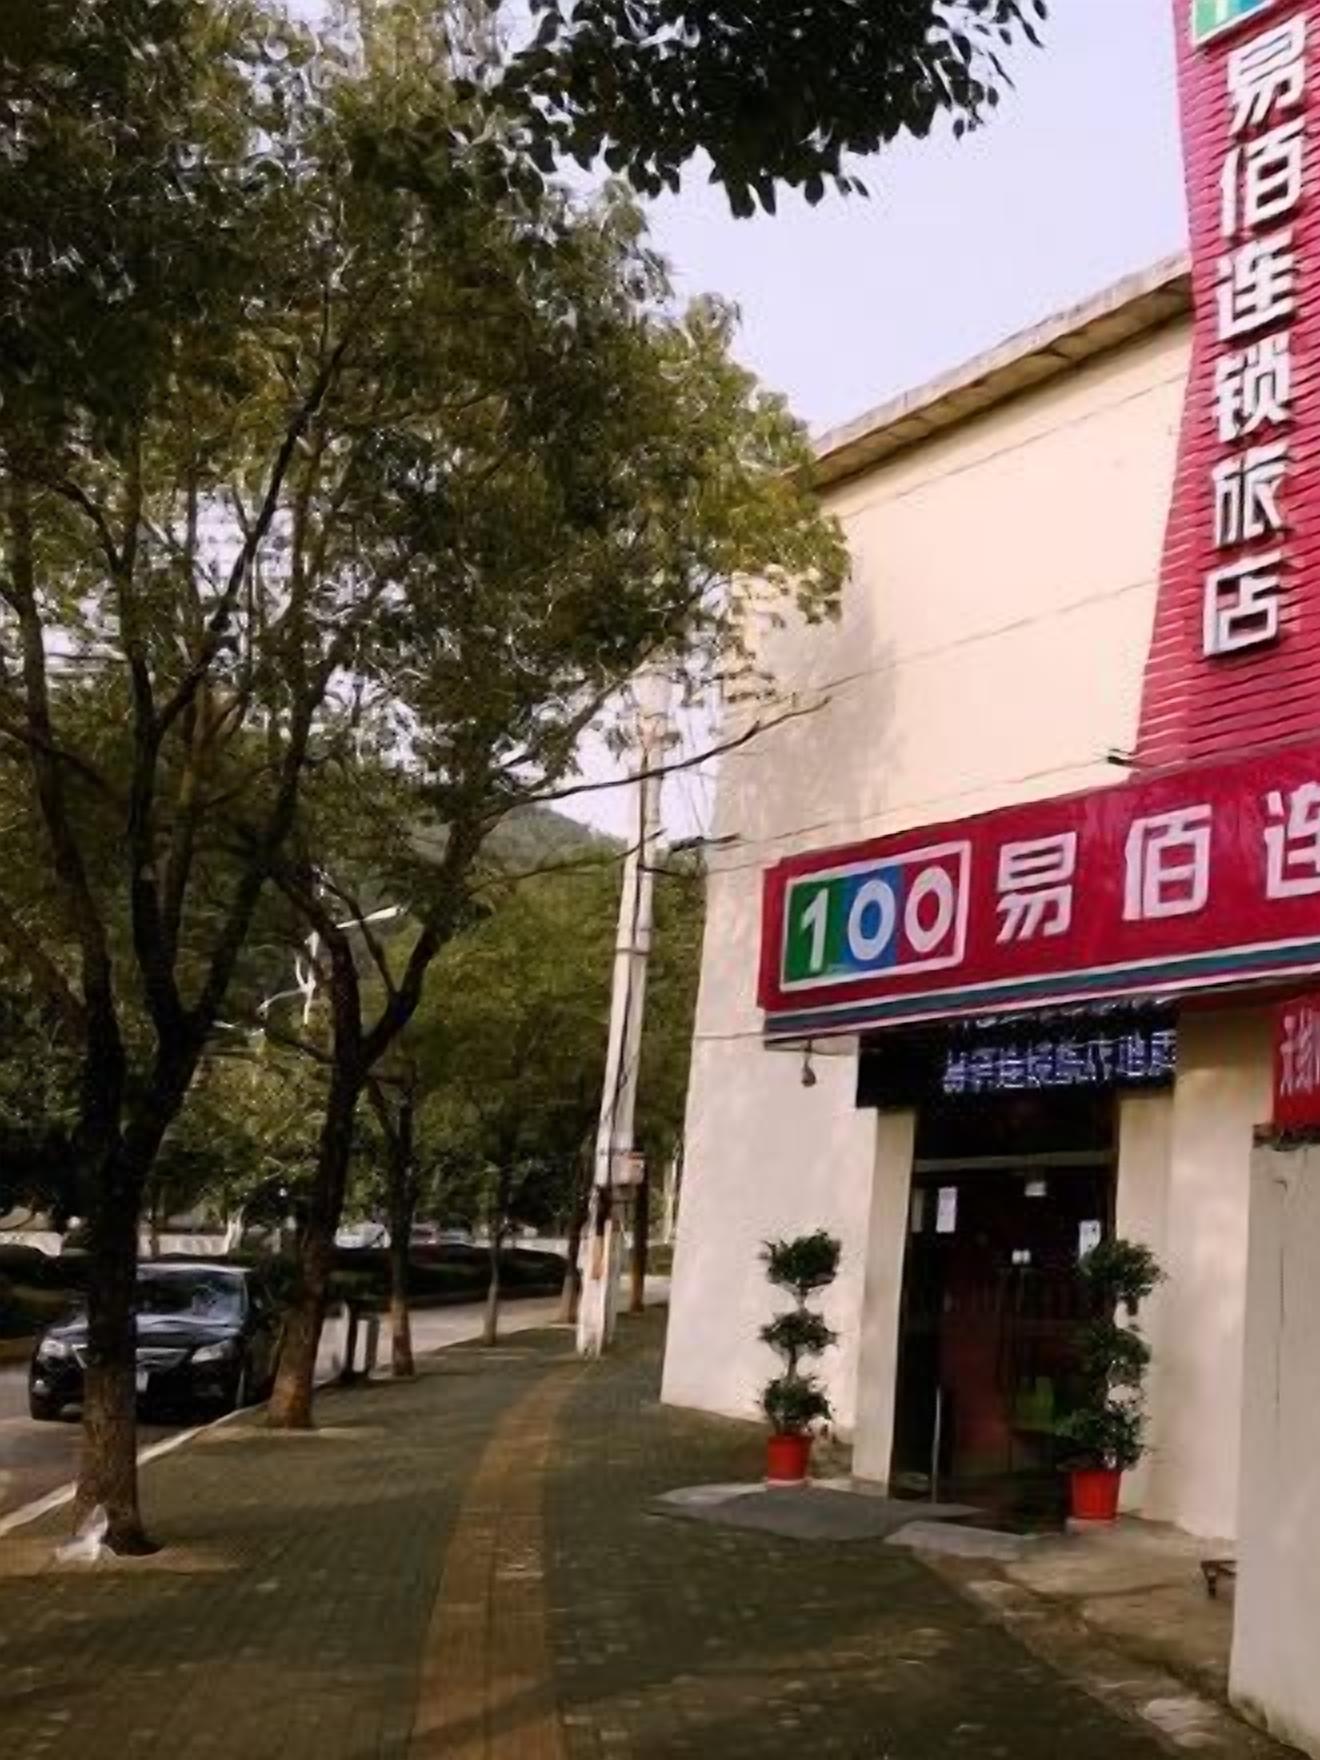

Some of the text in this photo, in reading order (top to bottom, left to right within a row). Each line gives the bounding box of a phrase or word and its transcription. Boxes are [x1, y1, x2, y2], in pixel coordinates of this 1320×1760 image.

[1203, 15, 1309, 658] 易佰连锁旅店
[800, 864, 955, 973] 100
